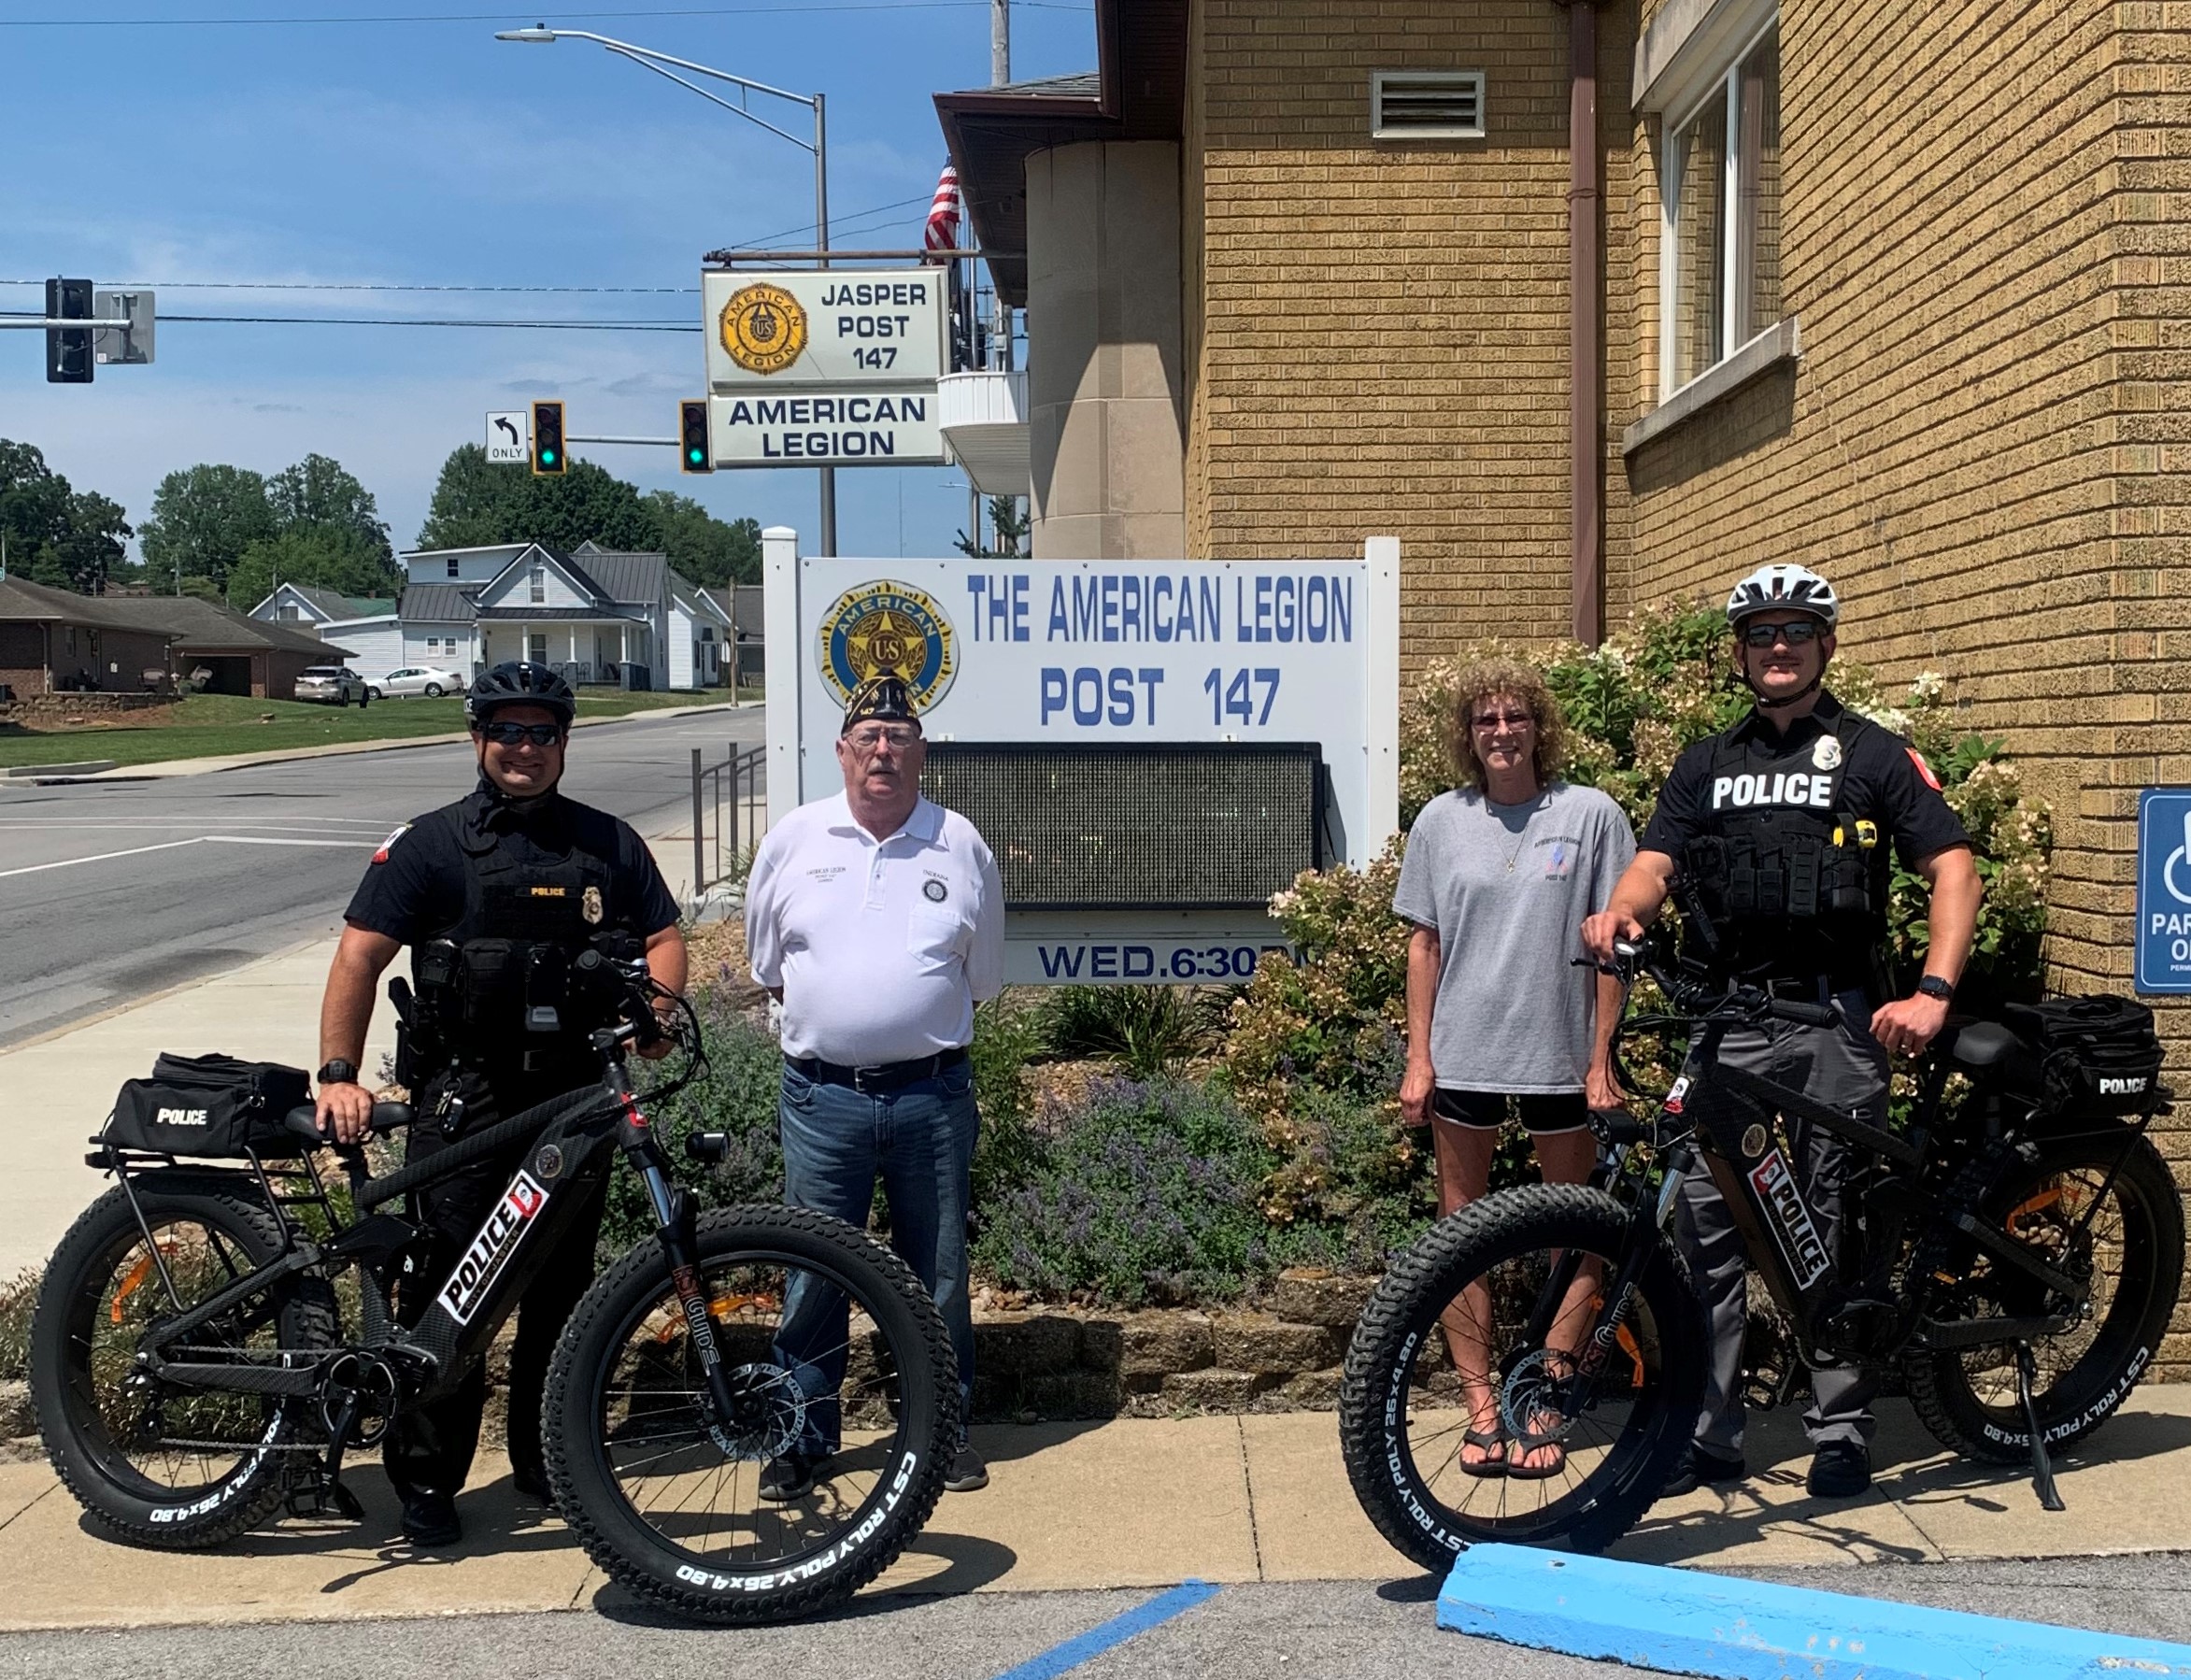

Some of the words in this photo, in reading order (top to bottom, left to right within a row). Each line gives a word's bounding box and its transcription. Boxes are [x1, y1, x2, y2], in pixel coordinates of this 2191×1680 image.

[727, 292, 800, 327] AMERICAN
[821, 284, 926, 306] JASPER
[838, 316, 910, 337] POST
[733, 345, 795, 365] LEGION
[853, 348, 898, 370] 147
[729, 397, 926, 425] AMERICAN
[492, 448, 522, 458] ONLY
[762, 431, 894, 457] LEGION
[837, 597, 937, 637] AMERICAN
[967, 575, 1030, 642] THE
[1047, 575, 1220, 643] AMERICAN
[1237, 576, 1352, 643] LEGION
[1041, 667, 1164, 726] POST
[1203, 668, 1280, 726] 147
[1713, 773, 1832, 810] POLICE
[531, 888, 565, 896] POLICE
[2099, 1077, 2148, 1094] POLICE
[157, 1108, 207, 1126] POLICE
[1772, 1179, 1827, 1276] POLICE
[445, 1202, 517, 1312] POLICE
[491, 1230, 519, 1271] JASPER
[2118, 1345, 2149, 1394] CST
[2082, 1388, 2118, 1427] ROLY
[2043, 1417, 2081, 1444] POLY
[1385, 1431, 1406, 1487] POLY
[885, 1451, 918, 1513] CST
[1398, 1488, 1434, 1531] ROLY
[839, 1507, 887, 1559] ROLY
[779, 1550, 837, 1587] POLY
